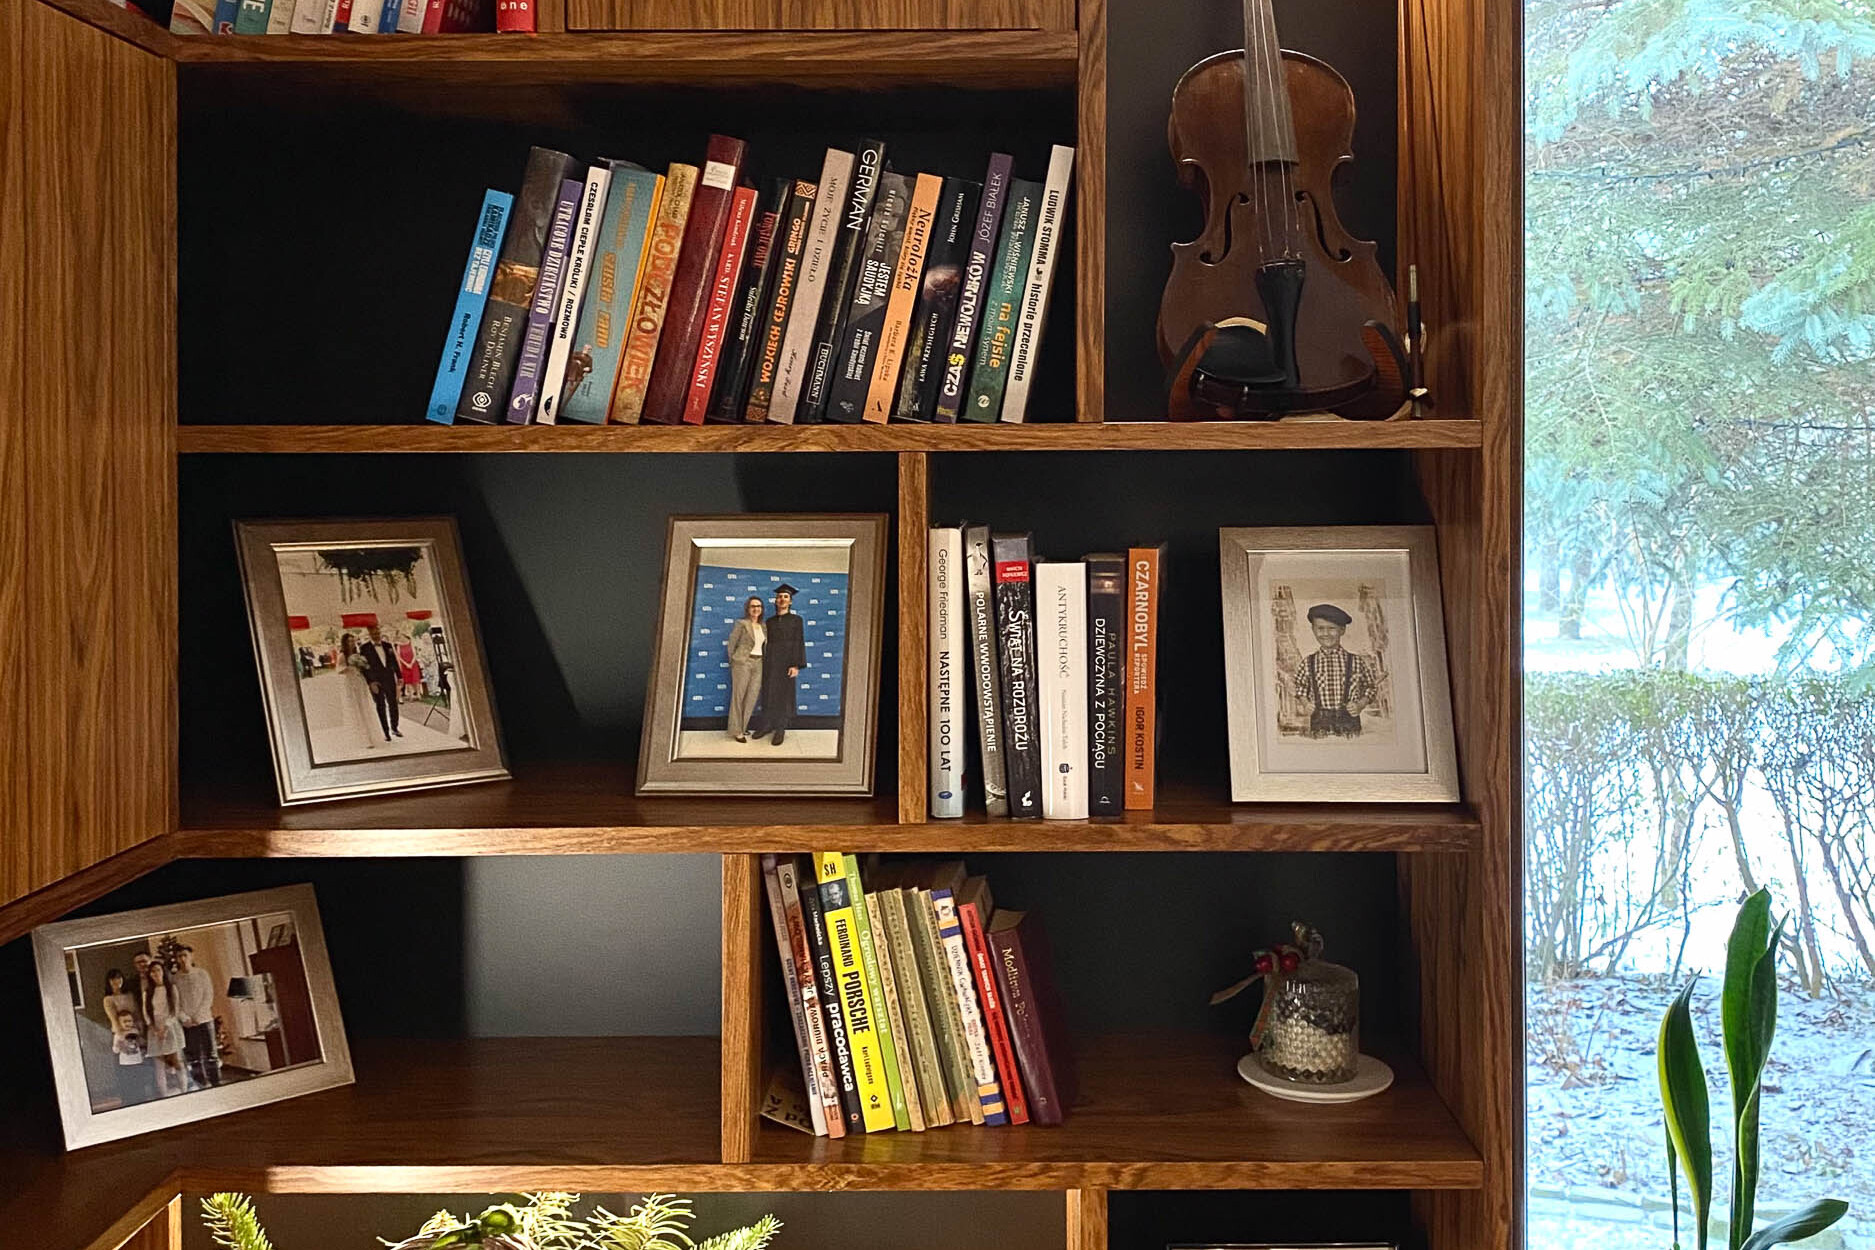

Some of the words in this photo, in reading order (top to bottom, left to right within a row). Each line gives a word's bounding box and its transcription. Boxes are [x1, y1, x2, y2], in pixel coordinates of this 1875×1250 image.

[582, 181, 599, 225] CZESAŁAM
[824, 176, 838, 203] MOJE
[845, 146, 879, 231] GERMAN
[950, 192, 965, 224] GRISHAM
[976, 209, 994, 242] JÓZEF
[985, 172, 1002, 209] BIAŁEK
[1043, 188, 1060, 225] LUDWIK
[549, 199, 574, 250] UTRACONE
[817, 206, 833, 236] ŻYCIE
[946, 224, 957, 243] JOHN
[1017, 196, 1031, 230] JANUSZ
[576, 226, 589, 254] CIEPŁE
[786, 217, 801, 253] GRINGO
[901, 207, 931, 292] Neurolożka
[1015, 231, 1023, 241] L.
[1035, 225, 1053, 266] STOMMA
[535, 249, 565, 315] DZIECIŃSTWO
[568, 256, 585, 289] KRÓLIKI
[806, 246, 822, 283] DZIEŁO
[853, 258, 880, 307] SAUDYJKĄ
[871, 261, 892, 297] JESTEM
[1003, 241, 1023, 295] WIŚNIEWSKI
[558, 297, 574, 339] ROZMOWA
[621, 220, 680, 394] PODCZŁOWIEK
[711, 275, 731, 320] STEFAN
[950, 249, 986, 350] NIEWOLNIKÓW
[998, 301, 1013, 322] na
[1025, 282, 1042, 321] historie
[457, 312, 471, 339] Robert
[524, 321, 545, 358] YEHUDA
[759, 324, 781, 383] WOJCIECH
[772, 257, 796, 323] CEJROWSKI
[890, 319, 902, 347] Barbara
[985, 307, 997, 335] moim
[448, 350, 460, 373] Frank
[694, 321, 721, 388] WYSZYŃSKI
[784, 347, 798, 374] Henry
[977, 335, 991, 366] synem
[985, 324, 1011, 369] fejsie
[1012, 321, 1034, 382] przecenione
[520, 360, 537, 378] NIR
[809, 346, 829, 399] BUCHMANN
[881, 358, 893, 382] Lipska
[937, 548, 948, 589] George
[938, 591, 949, 640] Friedman
[974, 591, 988, 640] POLARNE
[1134, 560, 1150, 651] CZARNOBYL
[1008, 609, 1029, 654] ŚWIAT
[1057, 585, 1070, 679] ANTYKRUCHOŚĆ
[1010, 657, 1023, 676] NA
[1095, 618, 1105, 695] DZIEWCZYNA
[1107, 633, 1116, 678] PAULA
[1140, 652, 1148, 689] SPOWIEDŹ
[937, 650, 950, 713] NASTĘPNE
[978, 642, 996, 752] WWODOWSTĄPIENIE
[939, 718, 950, 745] 100
[1011, 680, 1029, 751] ROZDROŻU
[1107, 688, 1116, 755] HAWKINS
[1135, 706, 1145, 731] IGOR
[940, 749, 950, 772] LAT
[1091, 713, 1104, 768] POCIĄGU
[1134, 733, 1144, 770] KOSTIN
[823, 863, 837, 876] SH
[848, 870, 861, 901] Thomas
[834, 917, 854, 967] FERDINAND
[817, 954, 836, 997] Lepszy
[857, 929, 880, 986] Ogrodowy
[871, 987, 889, 1034] warsztat
[841, 970, 870, 1035] PORSCHE
[809, 1004, 823, 1044] BIUROWA
[817, 1046, 830, 1078] PRACA
[825, 1001, 856, 1093] pracodawca
